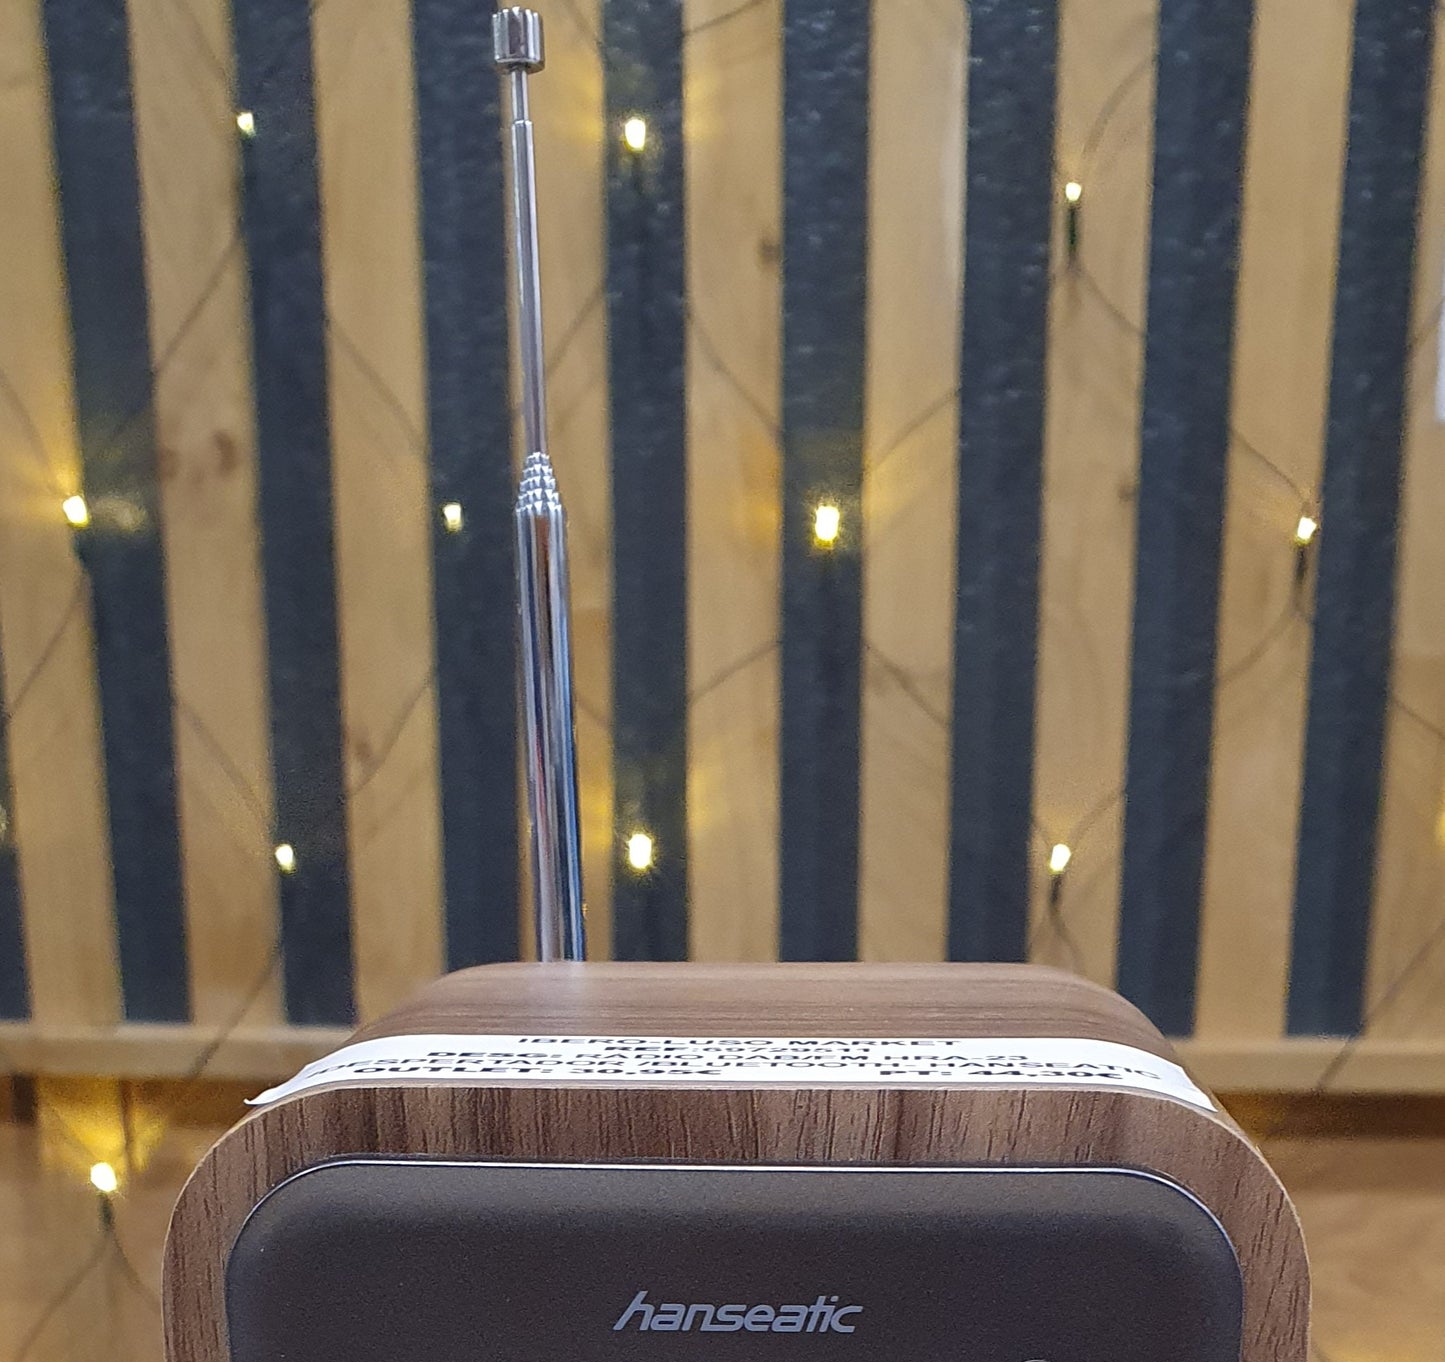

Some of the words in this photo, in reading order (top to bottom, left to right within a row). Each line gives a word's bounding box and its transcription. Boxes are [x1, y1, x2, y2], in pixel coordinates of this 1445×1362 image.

[518, 1038, 774, 1046] IBERO-LUSO
[353, 1066, 554, 1074] OUTLET:
[929, 1062, 1162, 1080] HANSEATIC
[612, 1290, 864, 1333] hanseatic
